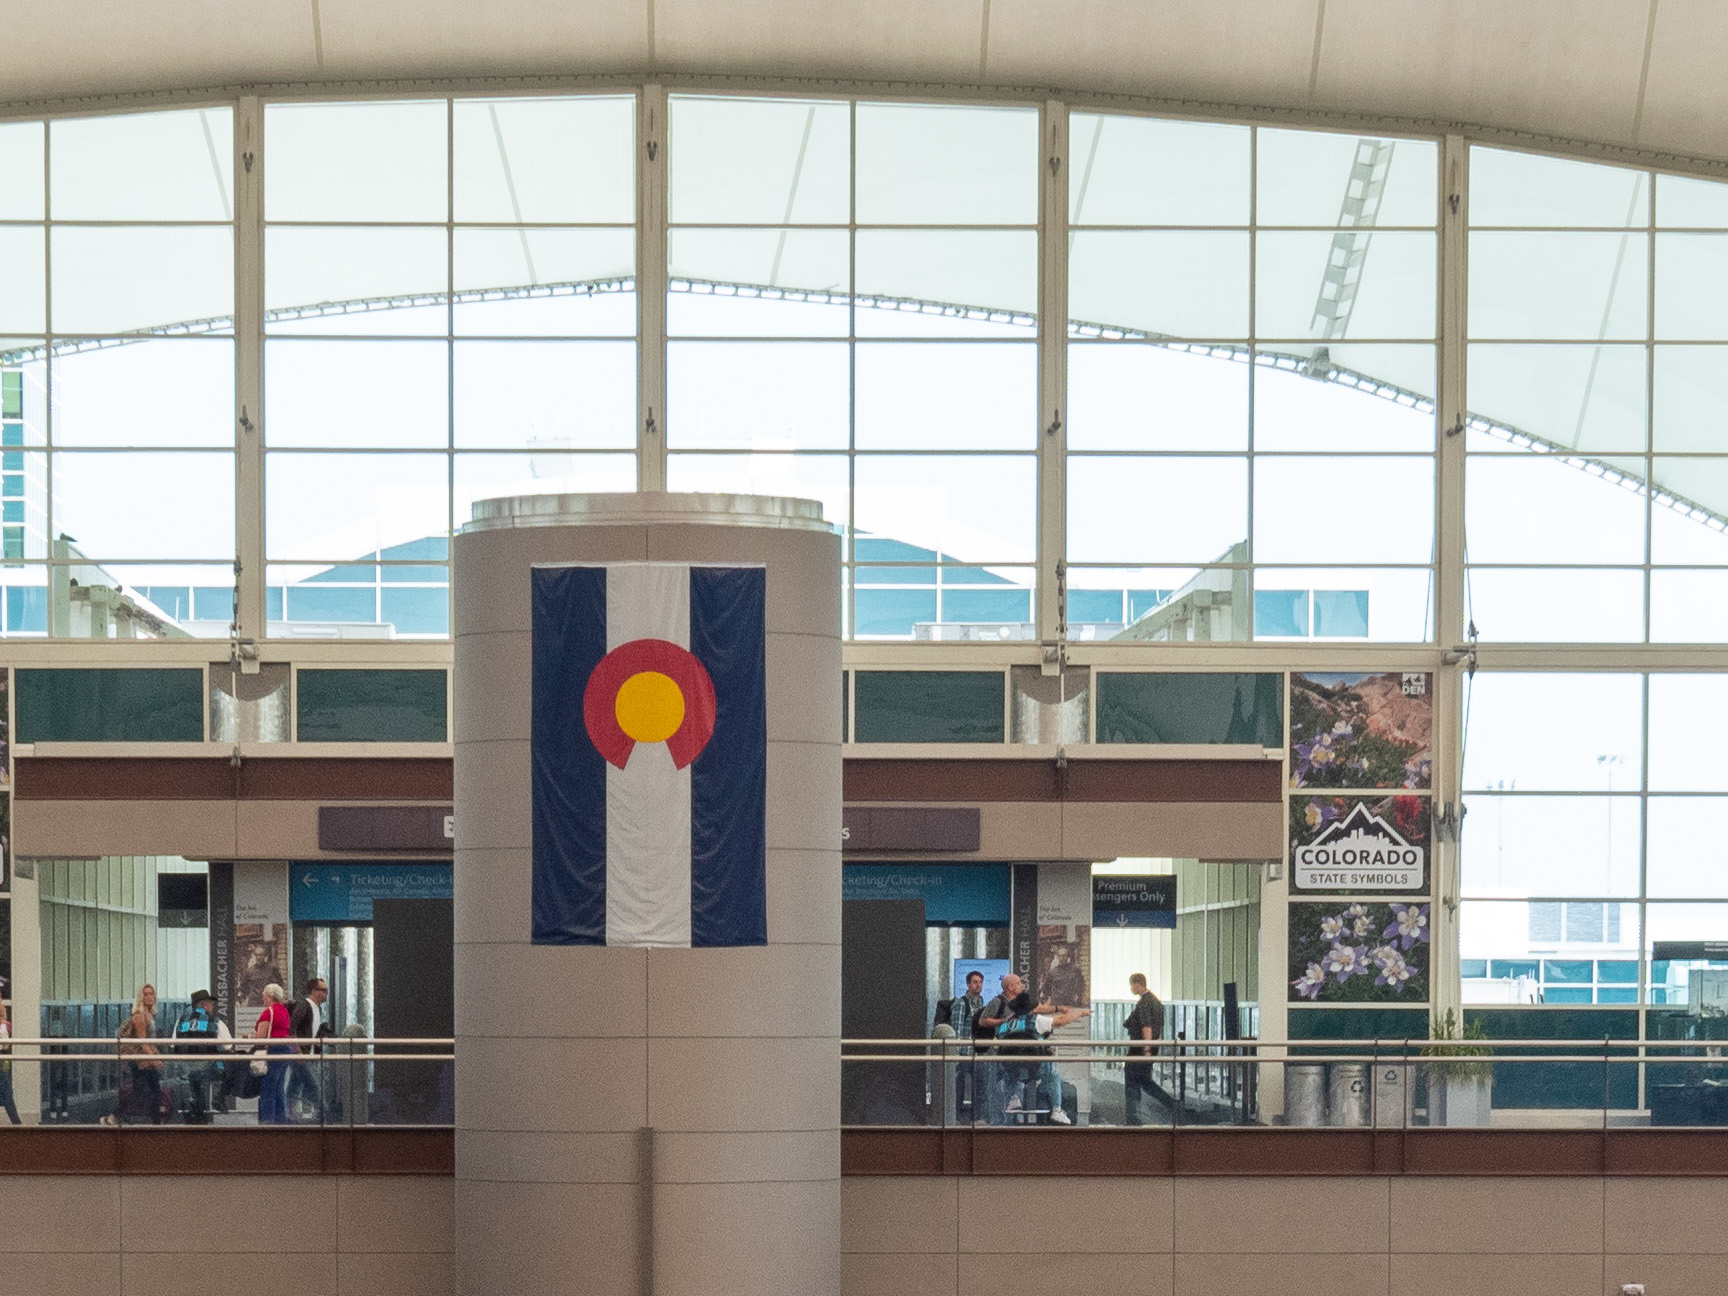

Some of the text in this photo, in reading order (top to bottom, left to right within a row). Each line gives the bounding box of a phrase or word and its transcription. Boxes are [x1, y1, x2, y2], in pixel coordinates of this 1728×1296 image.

[1403, 686, 1426, 695] DEN
[1301, 848, 1417, 865] COLORADO
[1310, 873, 1408, 885] STATE SYMBOLS
[1098, 881, 1146, 891] Premium
[1139, 892, 1165, 904] Only
